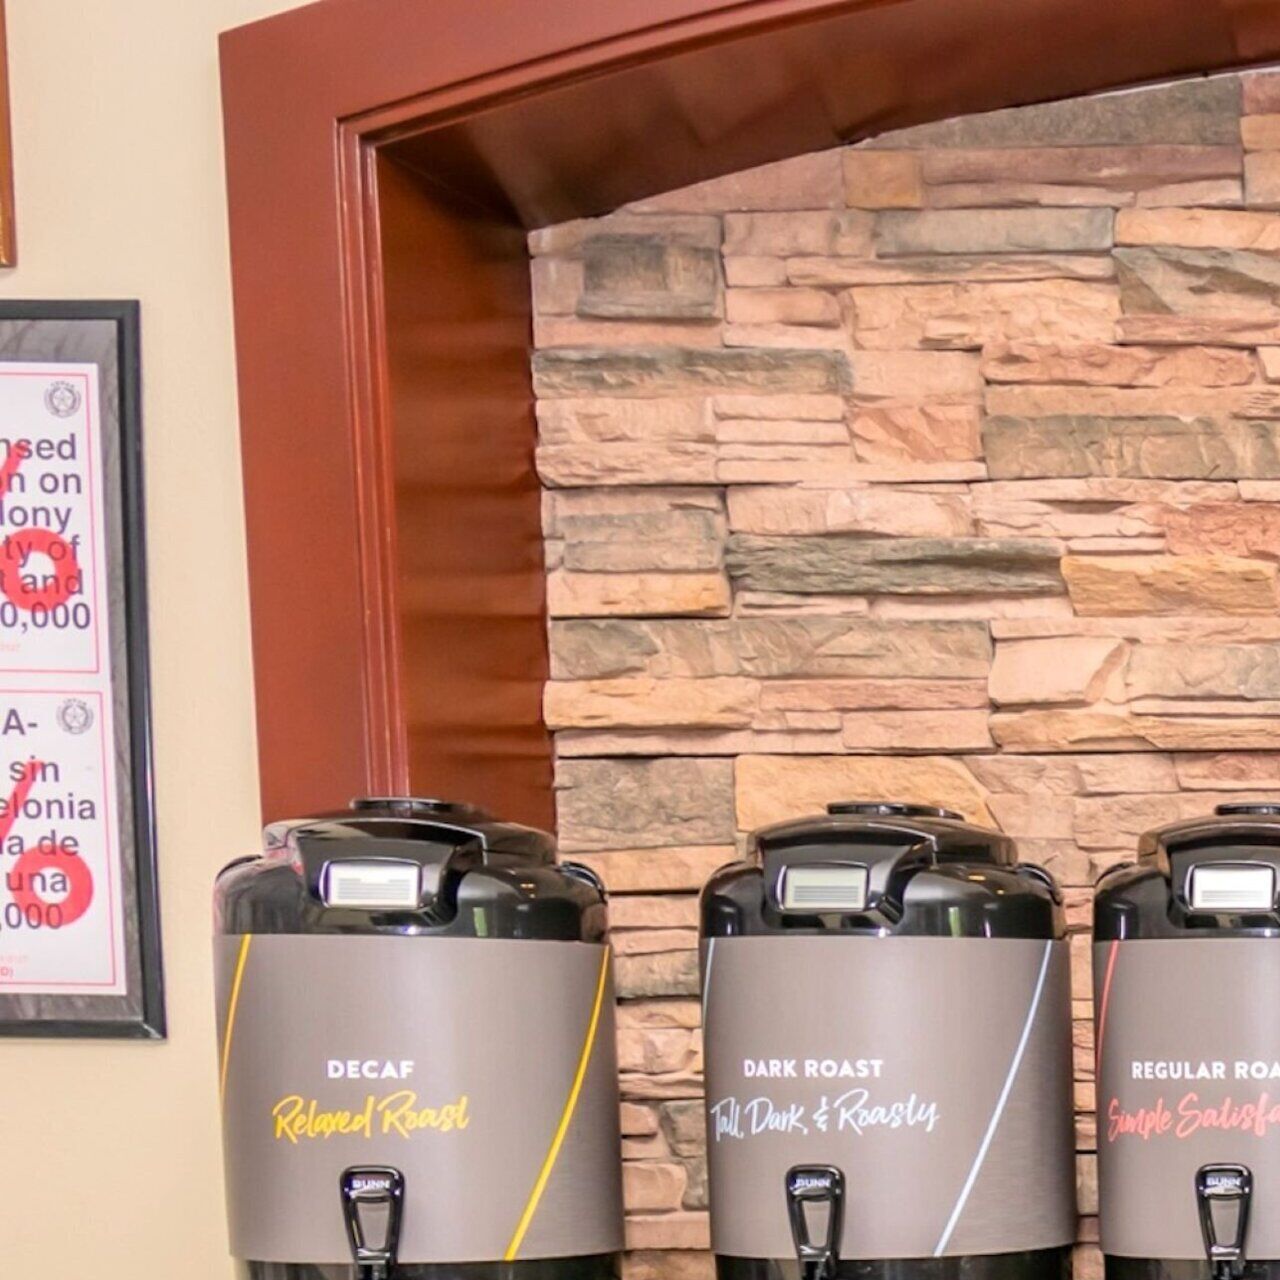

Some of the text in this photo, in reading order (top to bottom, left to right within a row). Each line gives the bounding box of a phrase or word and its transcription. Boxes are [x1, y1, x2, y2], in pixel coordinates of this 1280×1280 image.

[39, 472, 82, 494] on
[49, 535, 79, 561] of
[20, 570, 83, 596] and
[2, 708, 38, 735] A-
[9, 755, 60, 783] sin
[37, 829, 79, 856] de
[5, 871, 68, 893] una
[327, 1060, 414, 1078] DECAF
[744, 1059, 884, 1077] DARK ROAST
[1132, 1061, 1226, 1079] REGULAR
[273, 1090, 470, 1144] Relaxed Roast
[813, 1096, 829, 1132] &
[834, 1088, 940, 1136] Roasty
[1107, 1097, 1172, 1142] Simple
